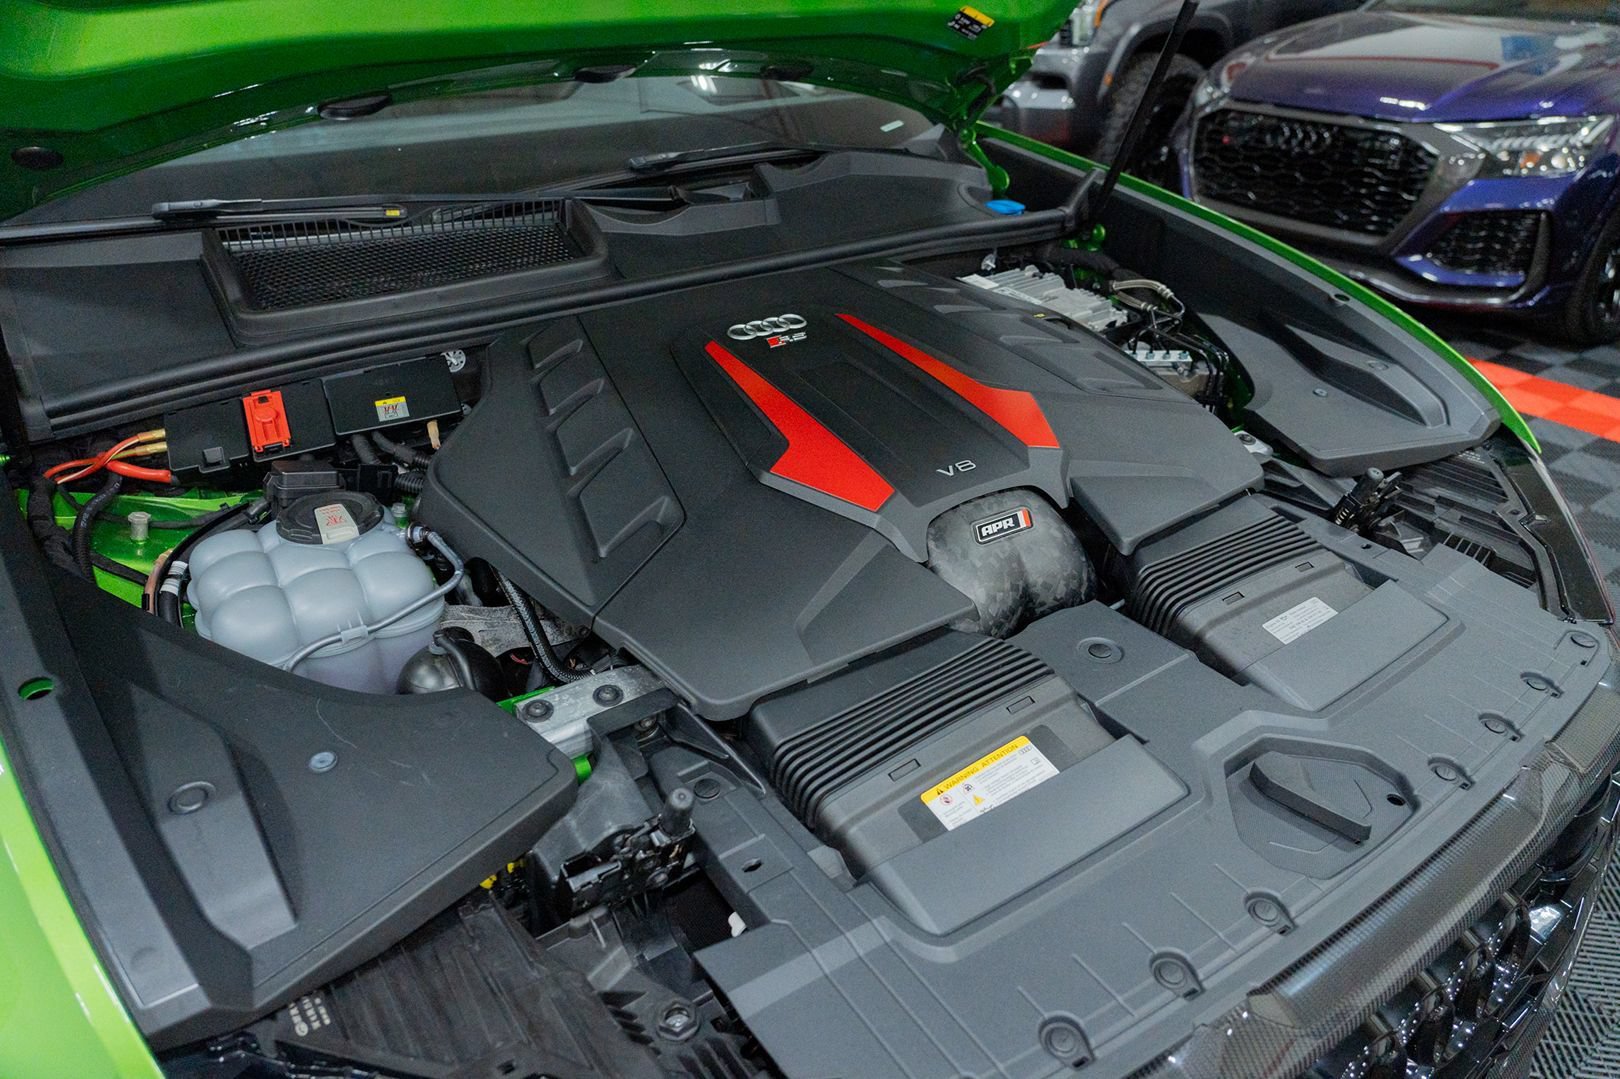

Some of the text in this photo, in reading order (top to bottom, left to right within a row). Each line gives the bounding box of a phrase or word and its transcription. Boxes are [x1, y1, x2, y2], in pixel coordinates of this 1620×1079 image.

[936, 460, 976, 476] V8
[981, 517, 1015, 537] APR
[944, 766, 980, 790] WARNING
[981, 743, 1019, 768] ATTENTION
